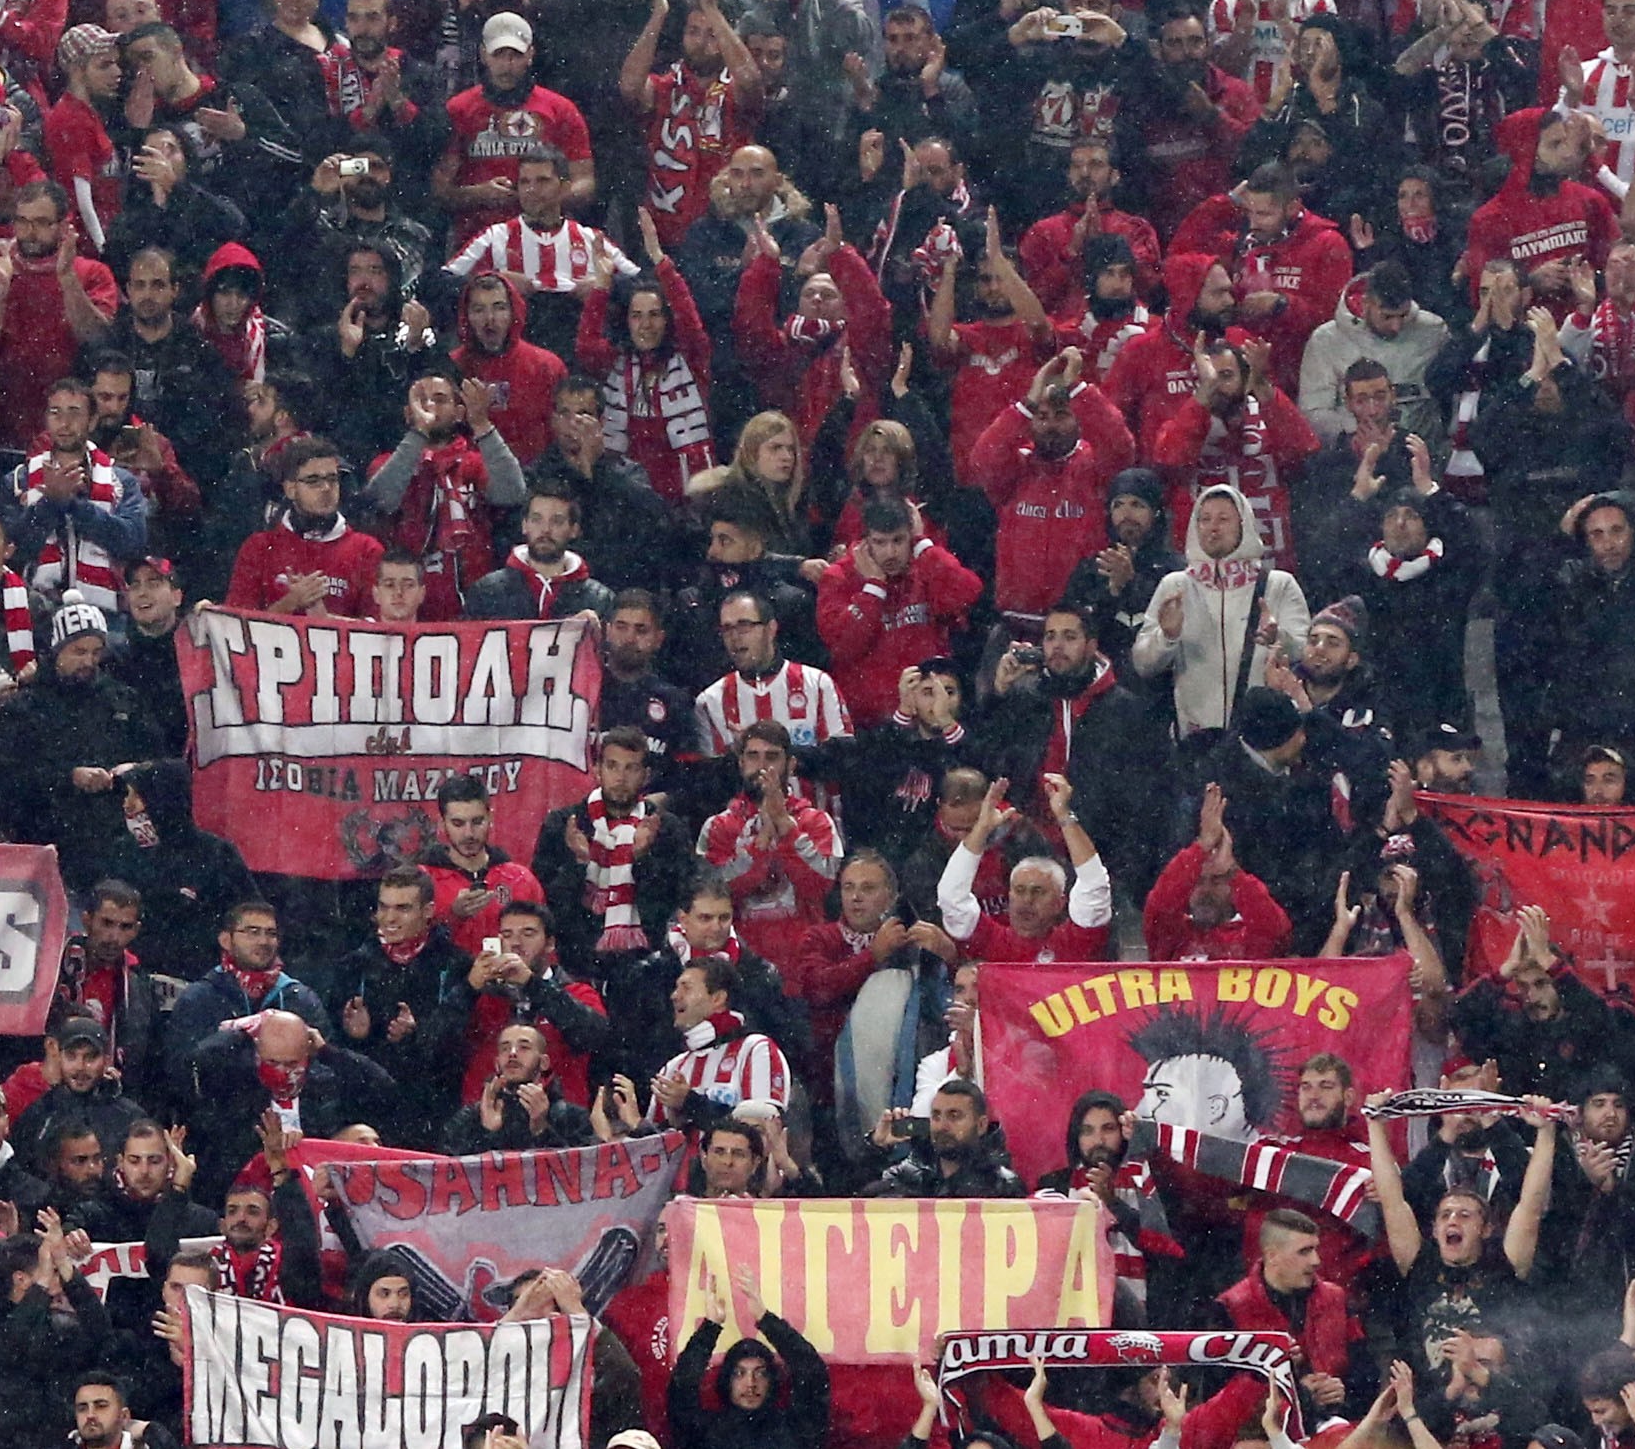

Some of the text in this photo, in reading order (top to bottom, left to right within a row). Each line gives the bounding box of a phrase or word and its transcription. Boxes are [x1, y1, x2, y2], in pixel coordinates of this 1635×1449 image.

[192, 612, 584, 731] ΤΡΙΠΟΛΗ
[1028, 967, 1359, 1038] ULTRA BOYS
[677, 1200, 1102, 1354] ΑΙΓΕΙΡΑ
[187, 1286, 590, 1448] MEGALOPOLI
[943, 1333, 1088, 1370] amia
